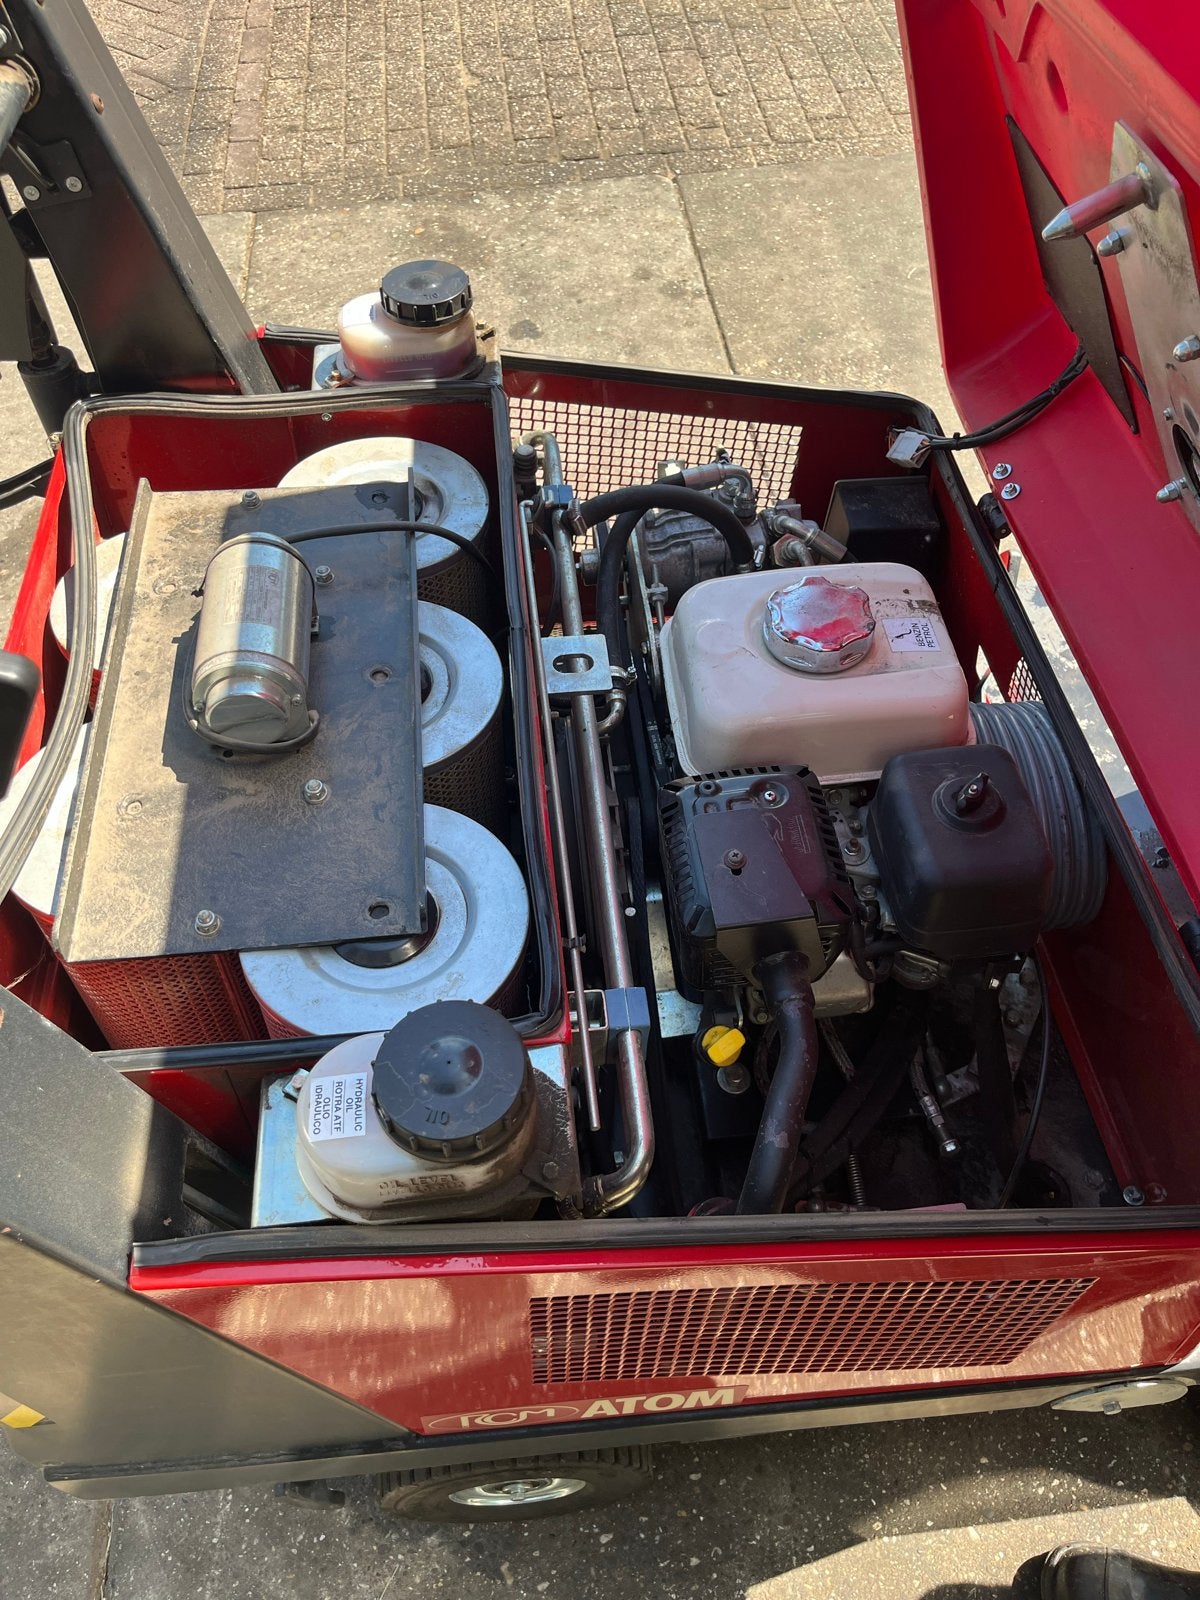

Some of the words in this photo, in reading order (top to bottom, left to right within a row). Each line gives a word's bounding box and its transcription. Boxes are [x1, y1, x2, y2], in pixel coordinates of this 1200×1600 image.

[911, 622, 925, 647] BENZIN
[921, 622, 936, 648] PETROL
[313, 1084, 323, 1135] IDRAULICO
[322, 1097, 331, 1120] OLIO
[334, 1081, 343, 1113] ROTRA
[345, 1097, 354, 1113] OIL
[354, 1078, 364, 1132] HYDRAULIC
[333, 1115, 342, 1132] ATF
[378, 1180, 408, 1190] OIL
[409, 1174, 457, 1186] LEVEL
[460, 1407, 555, 1428] RCM
[580, 1388, 736, 1419] ATOM
